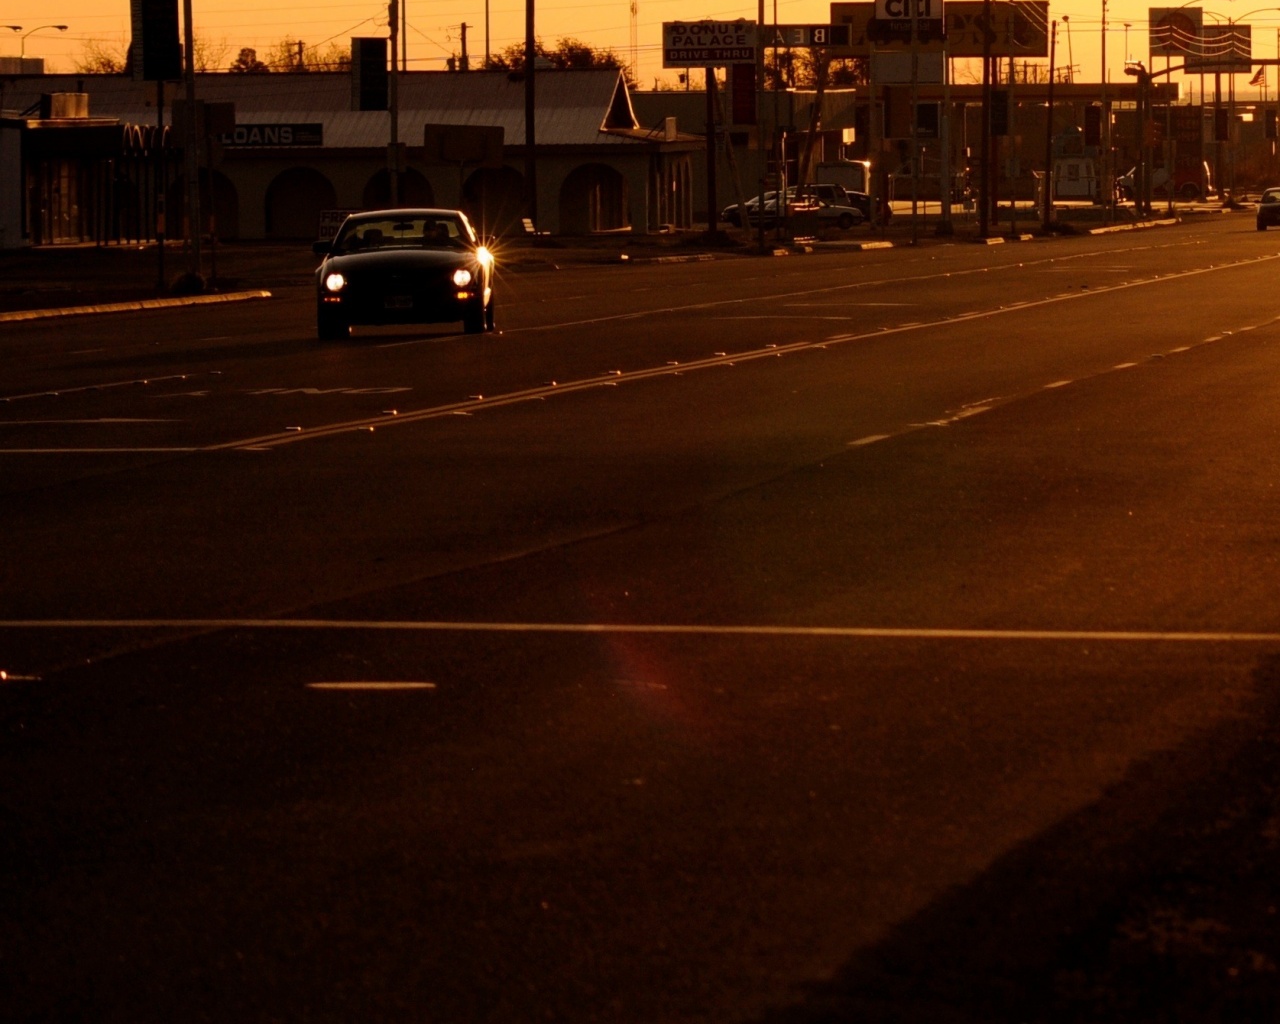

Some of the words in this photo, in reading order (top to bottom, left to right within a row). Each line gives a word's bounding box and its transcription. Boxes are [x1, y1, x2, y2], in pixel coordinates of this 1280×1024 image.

[674, 23, 744, 35] DONUT
[672, 35, 746, 47] PALACE
[669, 49, 710, 60] DRIVE
[713, 48, 750, 59] THRU
[221, 126, 294, 144] LOANS
